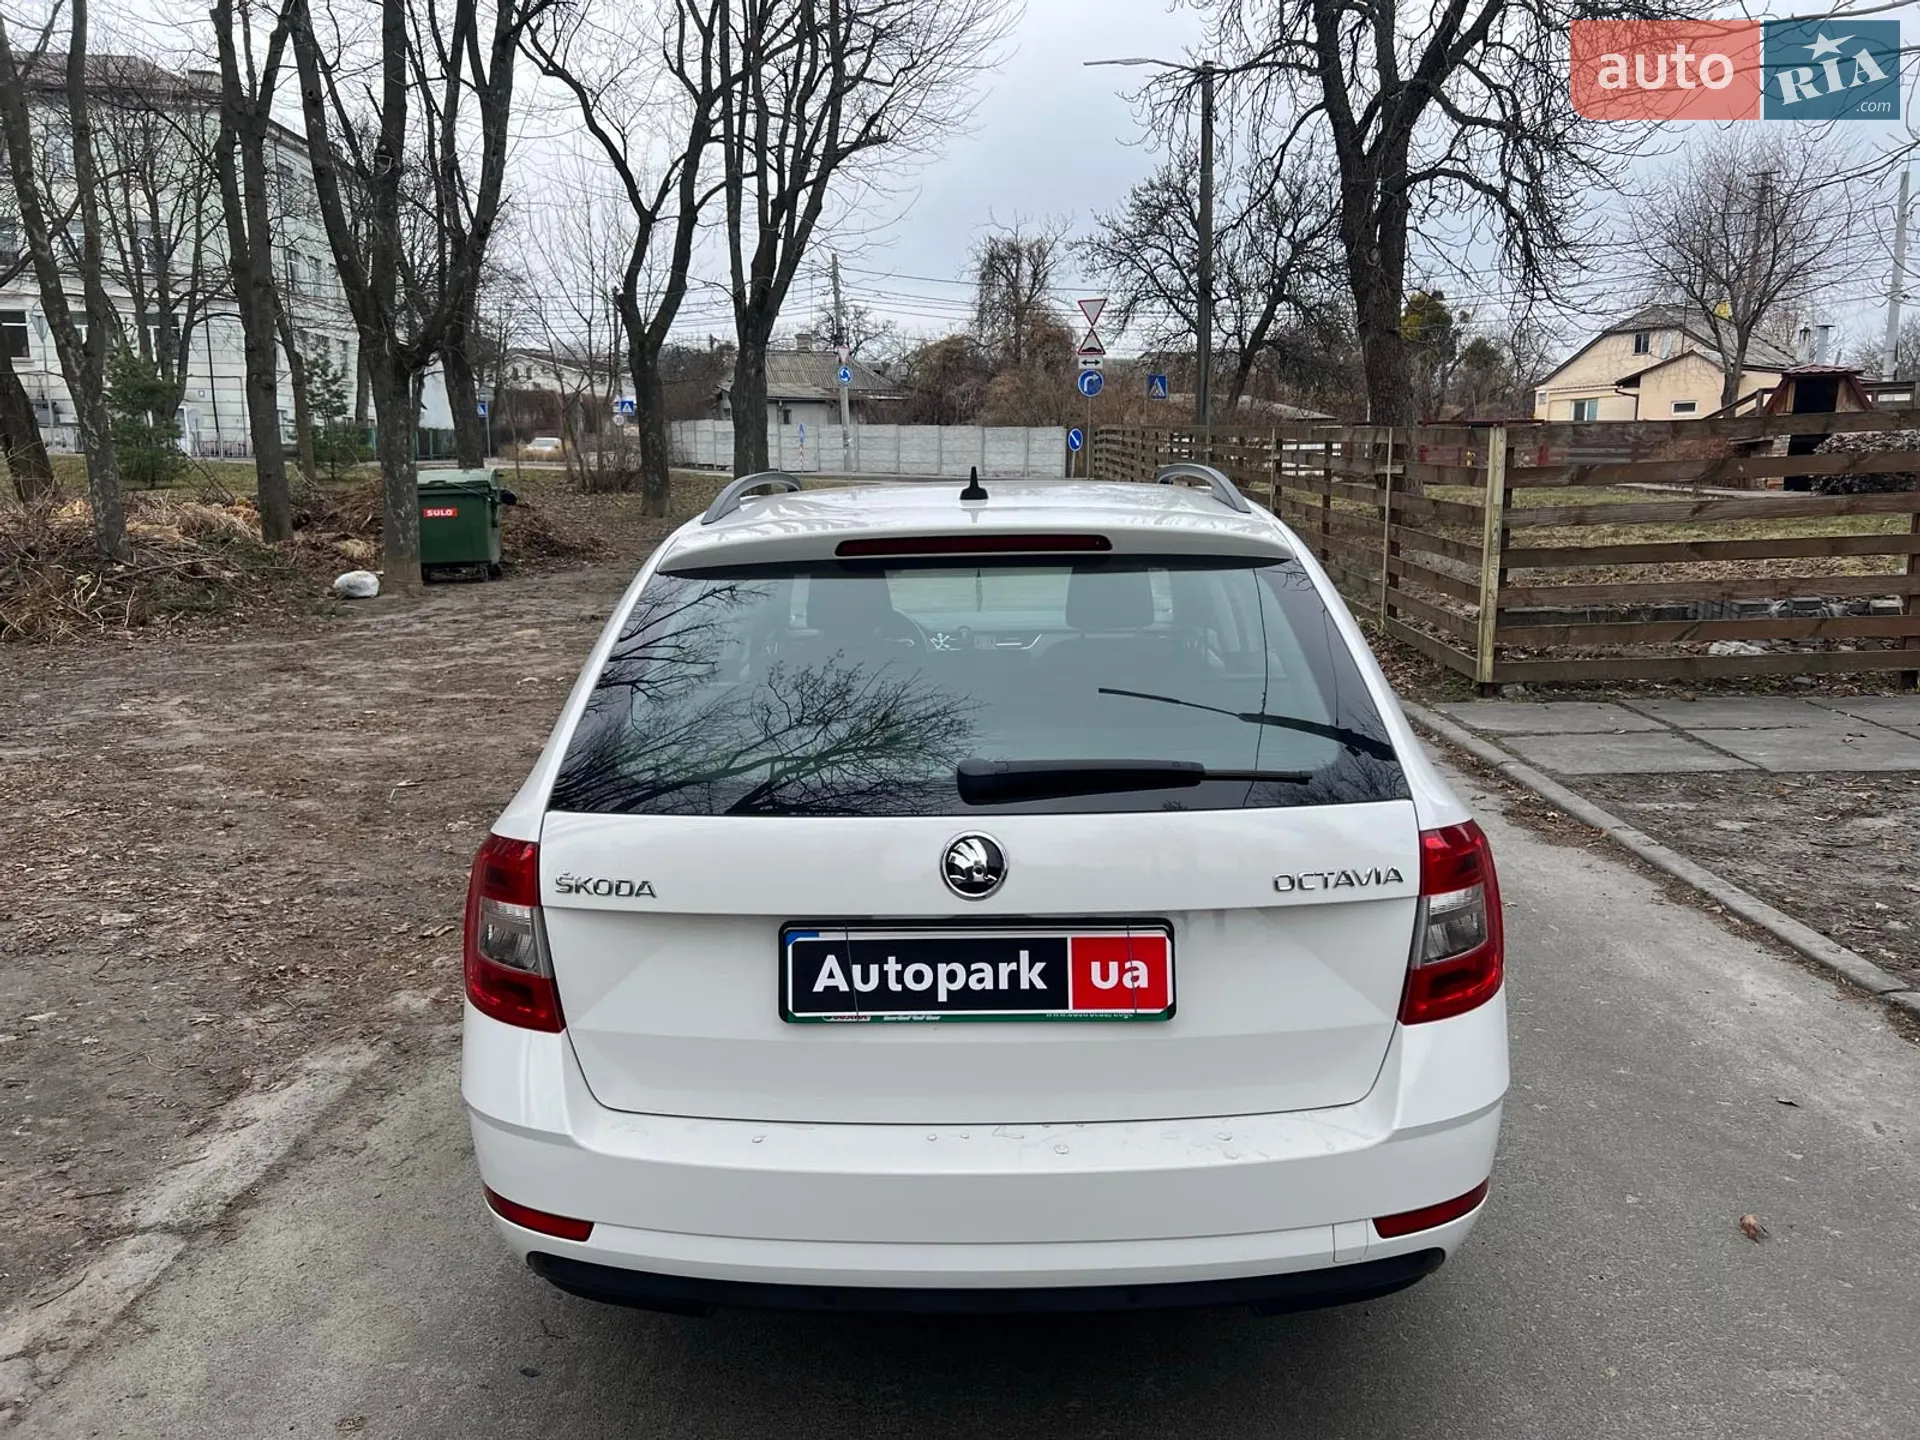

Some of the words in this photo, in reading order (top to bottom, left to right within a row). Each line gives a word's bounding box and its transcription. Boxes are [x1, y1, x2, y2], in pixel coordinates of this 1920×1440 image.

[427, 509, 453, 517] SULO
[556, 872, 658, 899] ŠKODA
[1273, 866, 1404, 892] OCTAVIA
[812, 950, 1048, 1002] Autopark
[1090, 959, 1149, 988] ua
